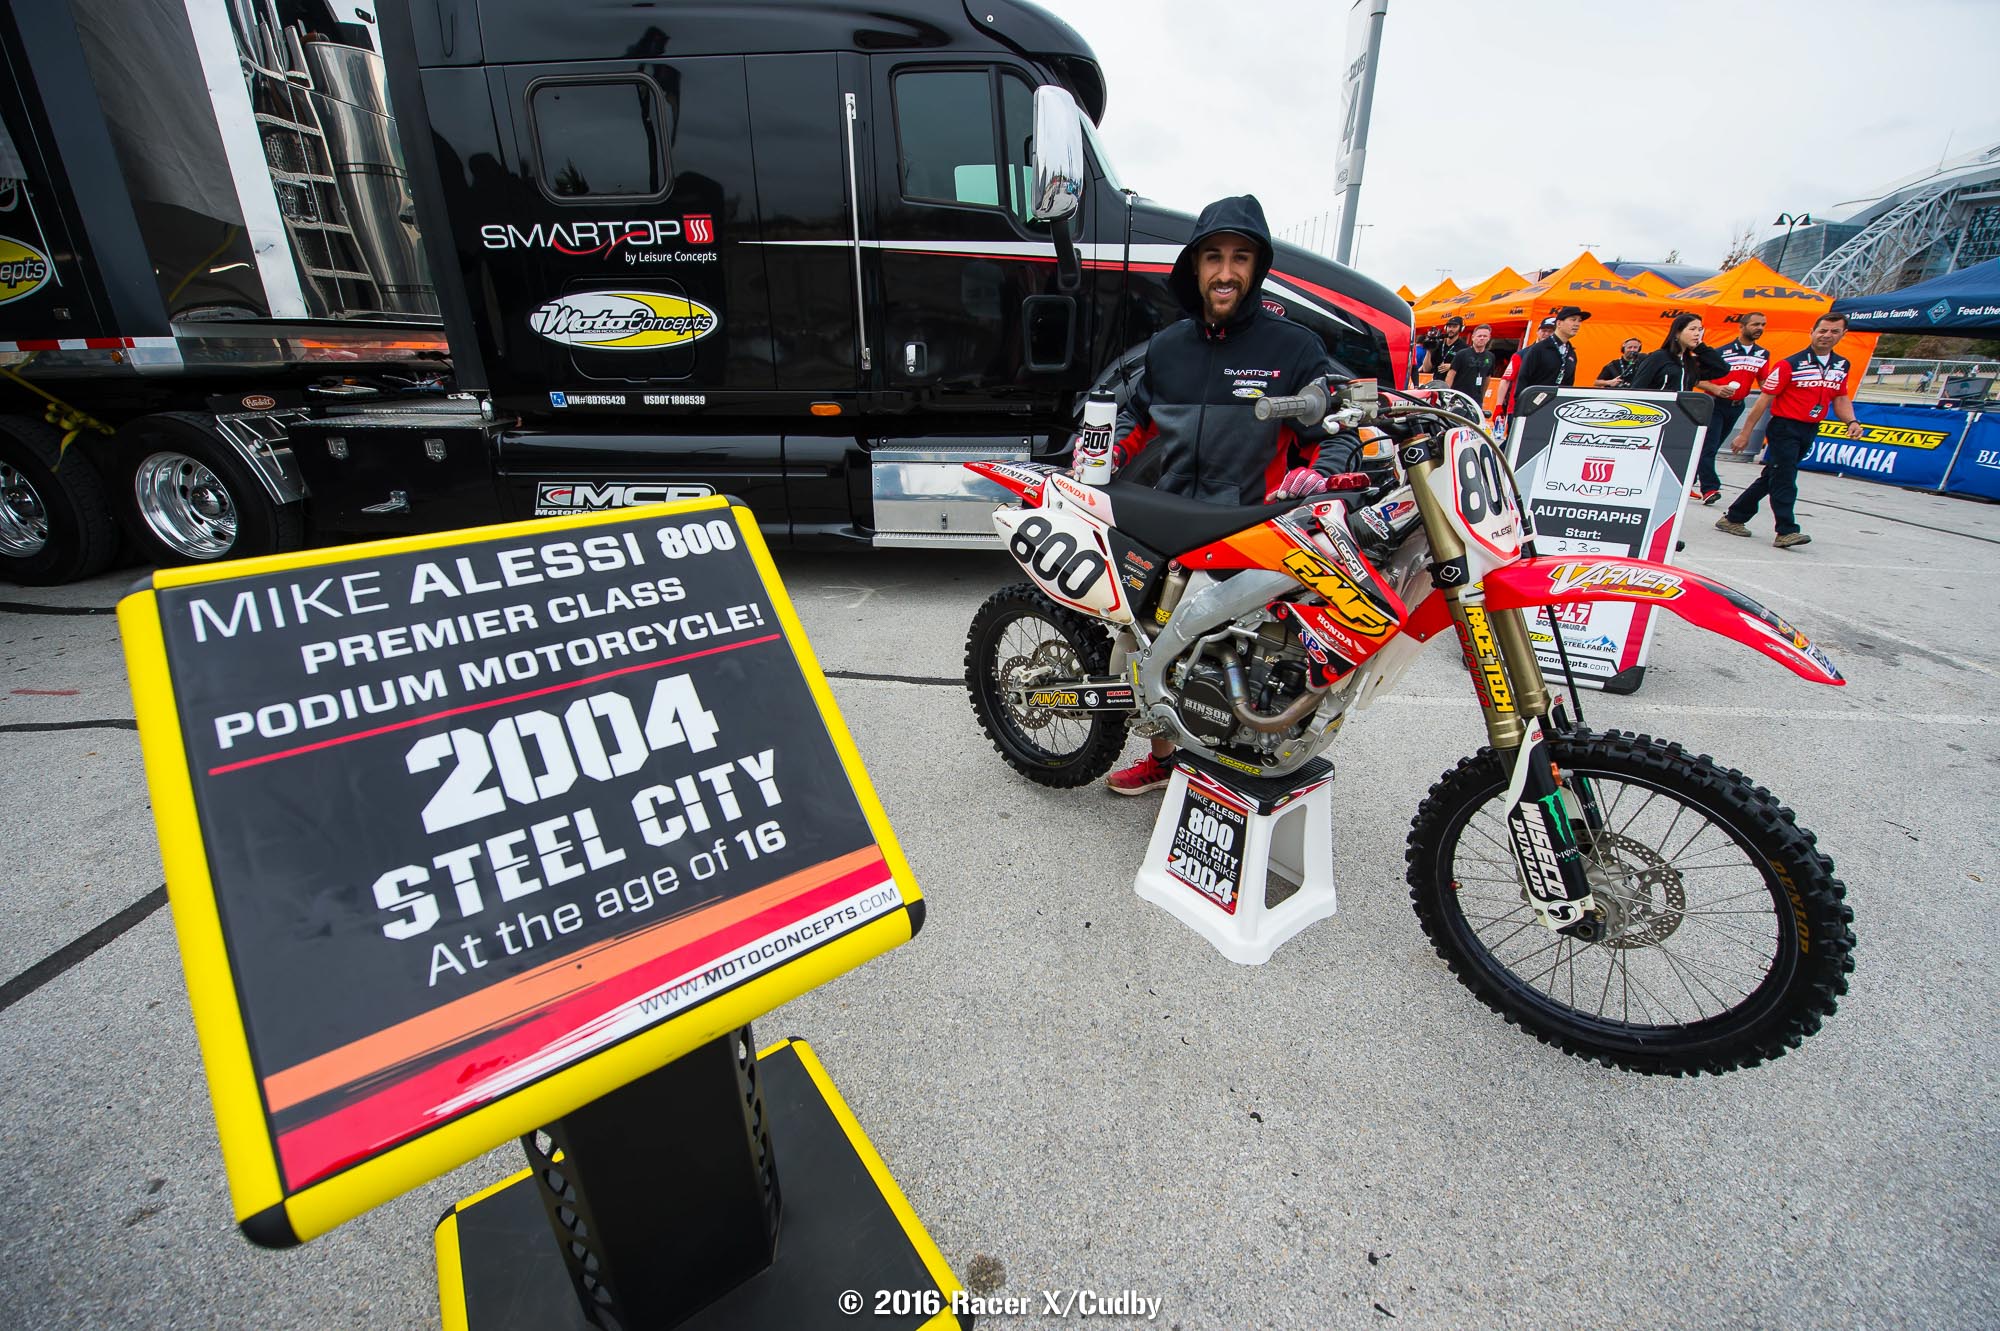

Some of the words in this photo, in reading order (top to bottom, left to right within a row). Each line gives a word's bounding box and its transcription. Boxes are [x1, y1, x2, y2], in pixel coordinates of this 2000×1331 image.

[481, 220, 681, 252] SMARTOP
[625, 252, 637, 265] by
[639, 251, 672, 262] Leisure
[674, 251, 717, 264] Concepts
[1743, 286, 1824, 302] KTM
[1957, 305, 1984, 316] Feed
[1224, 368, 1272, 378] SMARTOP
[1796, 380, 1841, 390] HONDA
[1083, 431, 1111, 449] 800
[1815, 441, 1898, 474] YAMAHA
[992, 465, 1041, 486] DUNLOP
[1056, 478, 1086, 502] HONDA
[1546, 481, 1642, 498] SMARTOP
[1535, 505, 1642, 525] AUTOGRAPHS
[1557, 541, 1568, 552] 2
[1577, 543, 1601, 553] 30
[1565, 527, 1602, 540] Start:
[1010, 516, 1108, 599] 800
[190, 571, 390, 643] MIKE
[409, 532, 646, 604] ALESSI
[656, 519, 737, 559] 800
[1282, 550, 1392, 629] FMF
[1551, 562, 1682, 594] VARNER
[301, 604, 539, 675] PREMIER
[547, 577, 686, 624] CLASS
[1317, 613, 1353, 647] HONDA
[1536, 619, 1587, 632] YOSIMURA
[1463, 606, 1498, 658] RACE
[1482, 659, 1516, 713] TECH
[1563, 641, 1586, 649] STEEL
[214, 668, 449, 749] PODIUM
[459, 602, 766, 691] MOTORCYCLE!
[1184, 698, 1232, 723] HINSON
[405, 673, 720, 834] 2004
[1188, 789, 1209, 807] MIKE
[1209, 802, 1244, 825] ALESSI
[1203, 808, 1215, 817] AGE
[372, 807, 627, 940] STEEL
[631, 748, 782, 847] CITY
[1188, 807, 1234, 852] 800
[1175, 838, 1211, 866] PODIUM
[1213, 862, 1238, 880] BIKE
[1178, 826, 1208, 854] STEEL
[1210, 846, 1238, 870] CITY
[1511, 817, 1547, 899] DUNLOP
[1519, 801, 1568, 899] WISECO
[1170, 847, 1234, 905] 2004
[428, 934, 488, 987] At
[495, 903, 583, 955] the
[595, 866, 680, 918] age
[689, 838, 729, 881] of
[734, 820, 787, 861] 16
[638, 887, 897, 1016] WWW.MOTOCONCEPTS.COM
